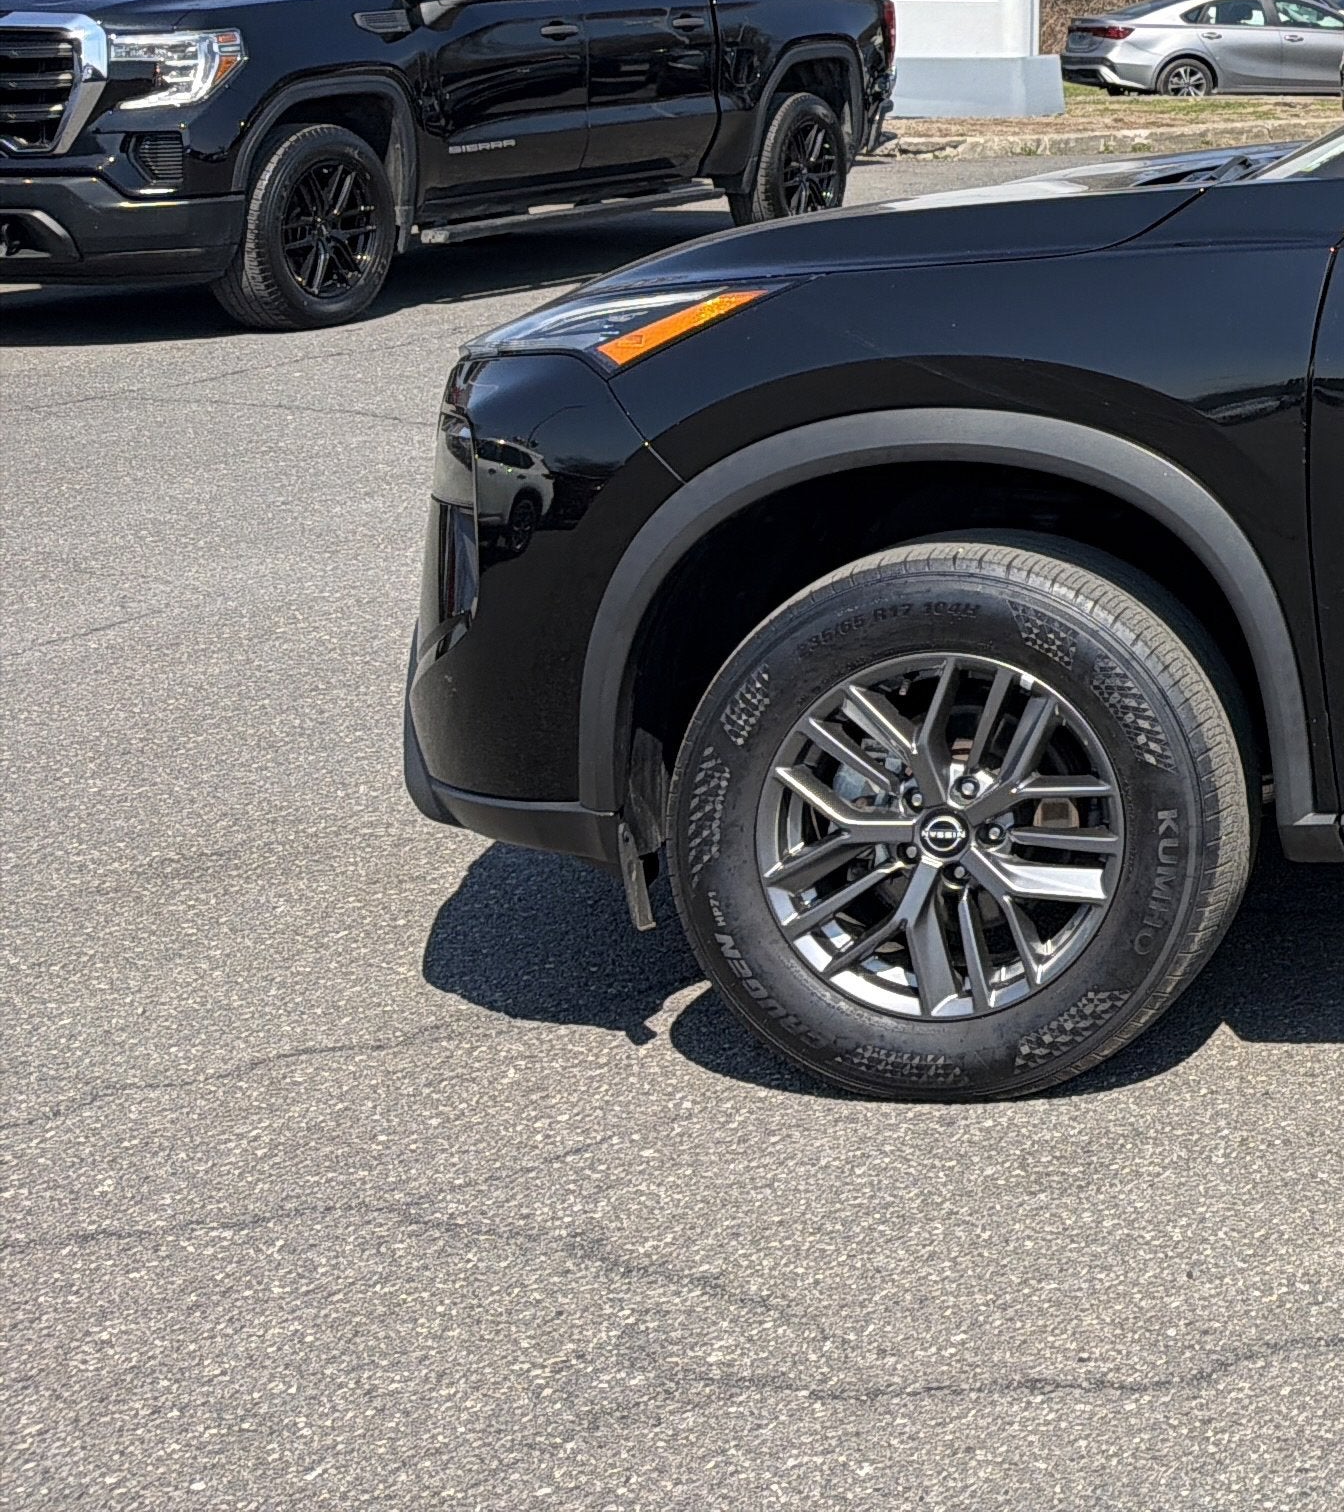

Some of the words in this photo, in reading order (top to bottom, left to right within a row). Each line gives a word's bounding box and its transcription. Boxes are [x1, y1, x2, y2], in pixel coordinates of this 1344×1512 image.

[448, 139, 517, 155] SIERRA
[921, 830, 966, 839] NISSAN
[1134, 808, 1179, 956] KUMHO
